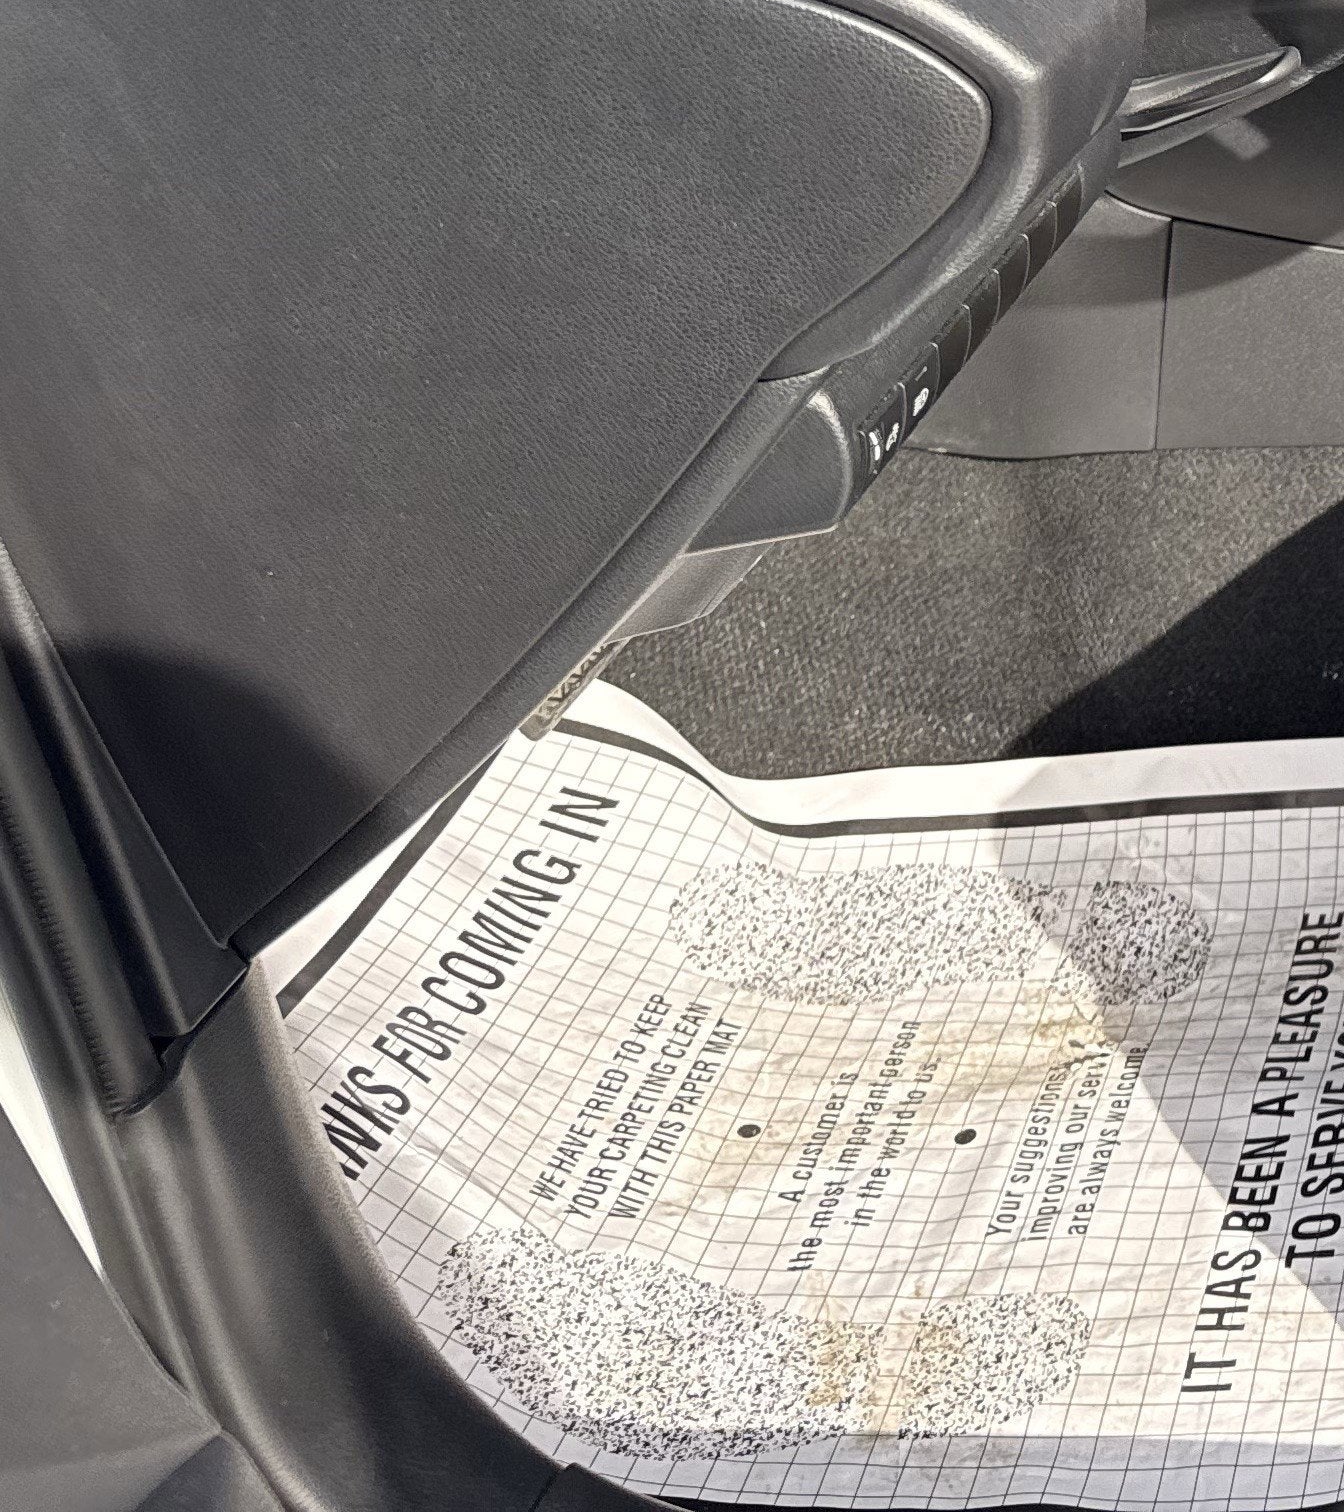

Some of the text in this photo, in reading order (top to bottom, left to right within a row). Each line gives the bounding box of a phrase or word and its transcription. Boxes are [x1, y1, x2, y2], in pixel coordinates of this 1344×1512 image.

[319, 783, 619, 1181] NKS FOR COMING IN
[528, 990, 673, 1202] WE HAVE TRIED TO KEEP
[562, 1000, 712, 1219] YOUR CARPETING CLEAN
[607, 1016, 743, 1220] WITH THIS PAPER MAT
[777, 1069, 858, 1202] A customer is
[786, 1020, 921, 1270] the most important person
[843, 1057, 941, 1225] in the world to us.
[985, 1191, 1023, 1236] Your
[1009, 1072, 1067, 1182] suggestions
[1021, 1140, 1083, 1242] improving
[1064, 1103, 1091, 1132] our
[1067, 1042, 1150, 1235] are always welcome.
[1179, 909, 1344, 1392] IT HAS BEEN A PLEASURE
[1283, 1215, 1342, 1266] TO
